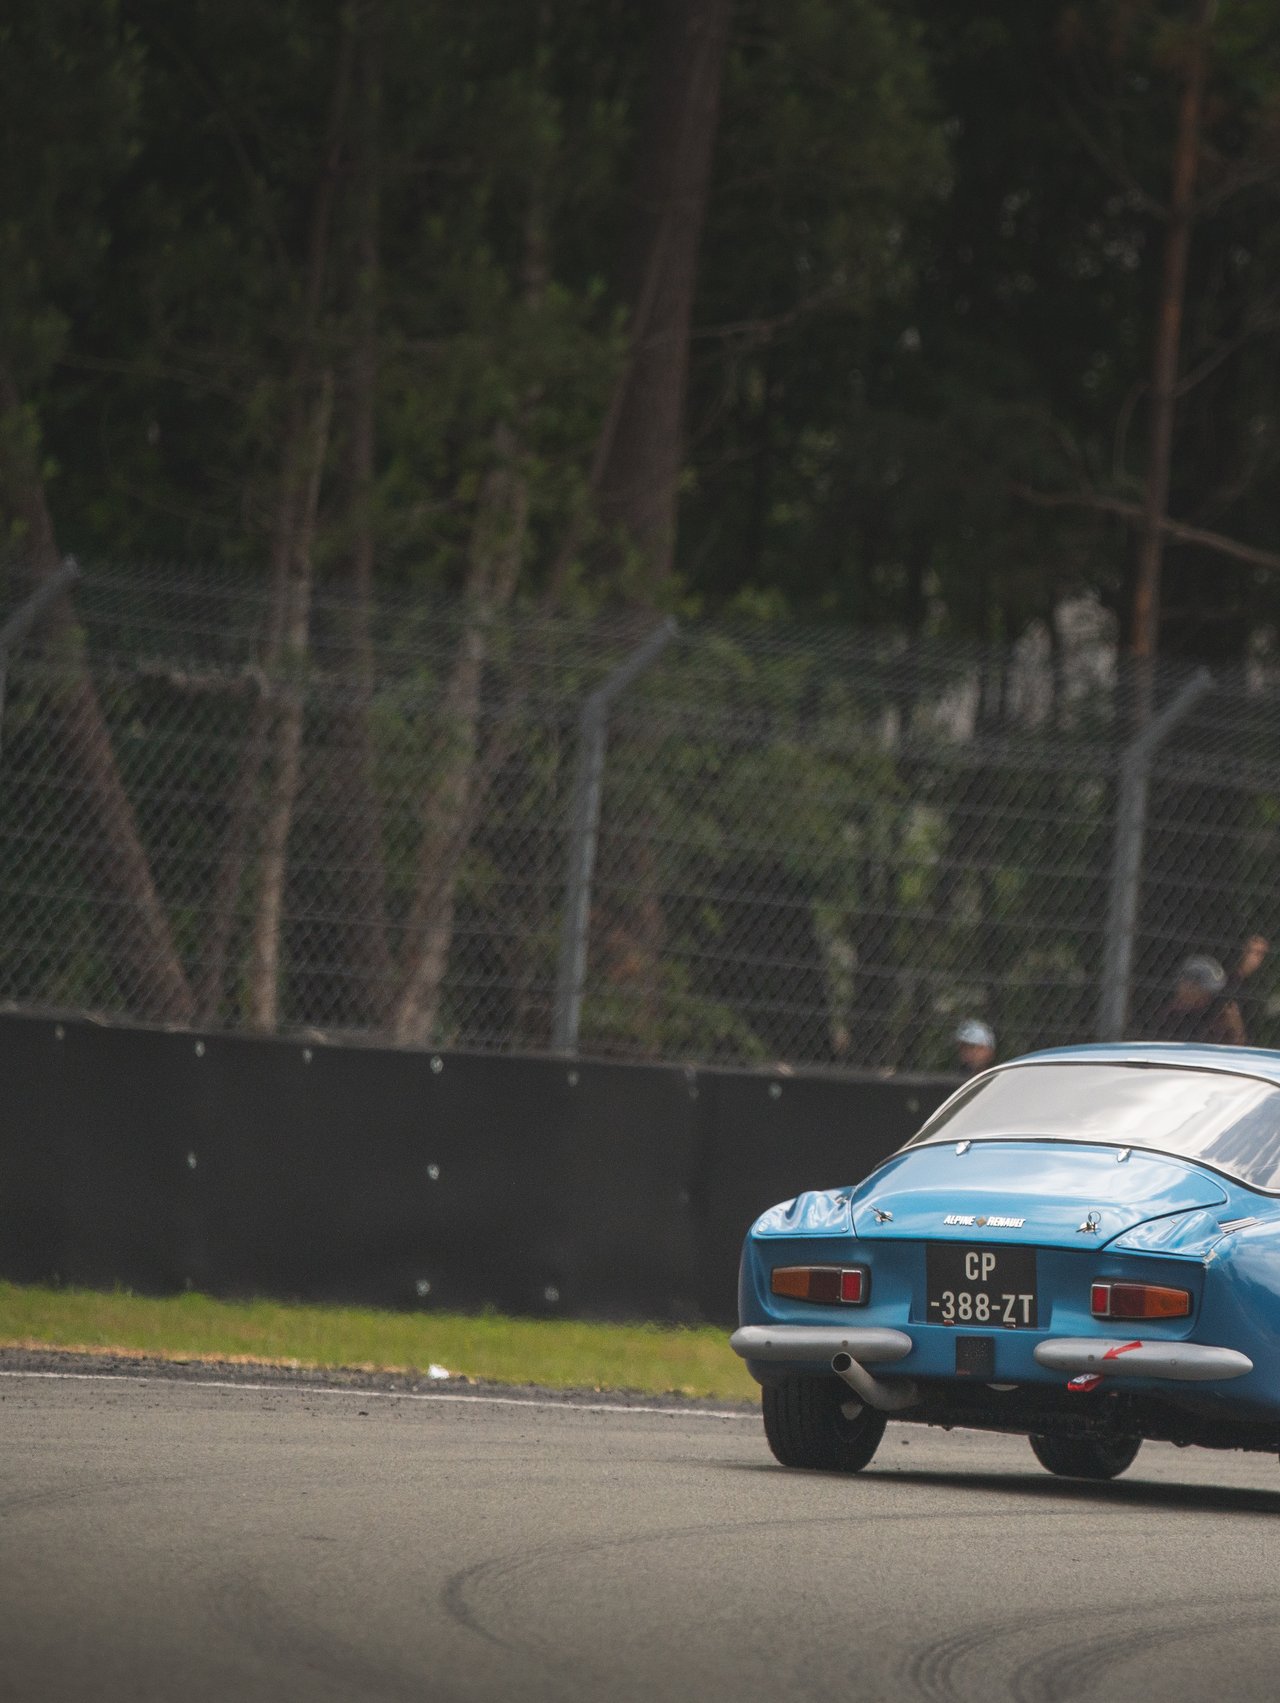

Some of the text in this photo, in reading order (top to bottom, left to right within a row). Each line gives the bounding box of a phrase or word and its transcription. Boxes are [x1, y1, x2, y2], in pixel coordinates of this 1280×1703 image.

[944, 1215, 1026, 1228] ALPINE RENAULT
[965, 1251, 996, 1281] CP
